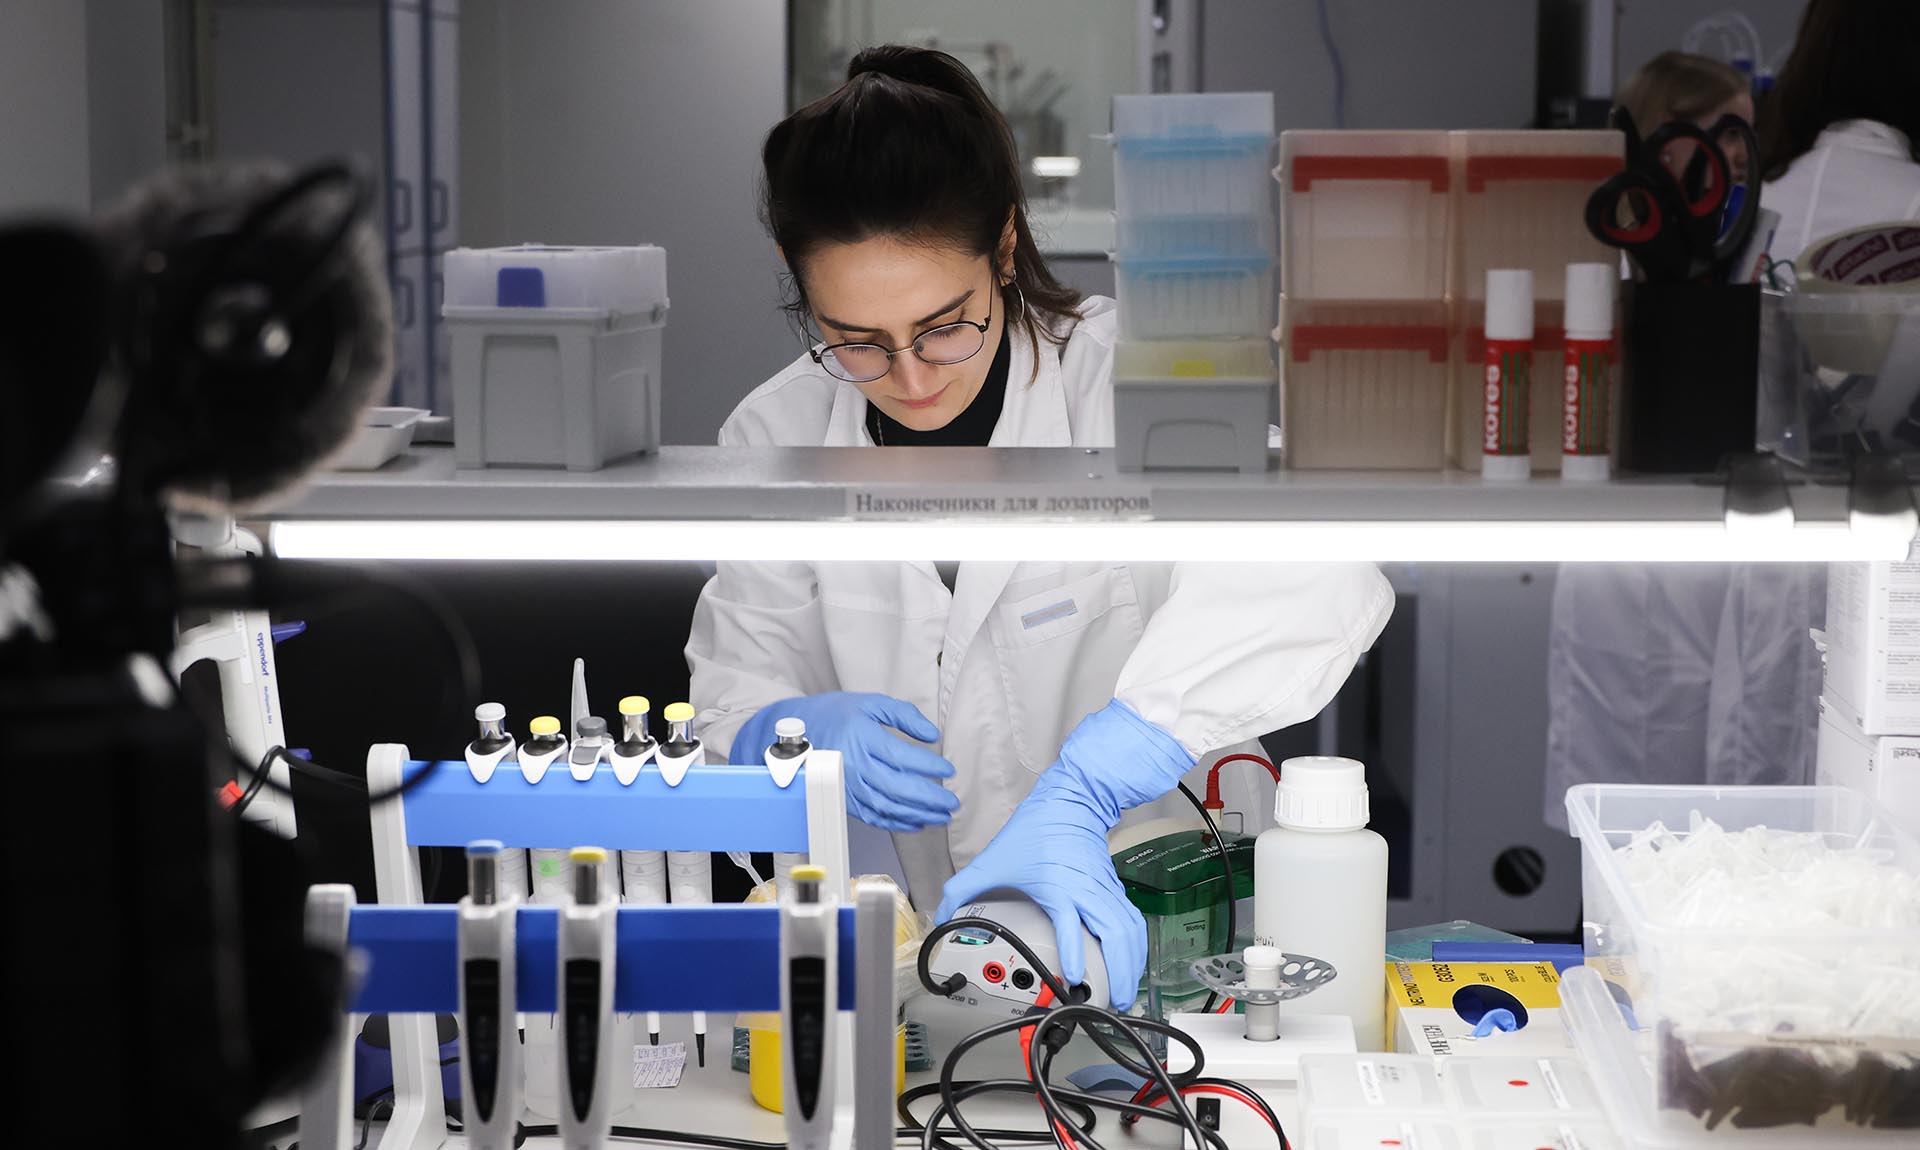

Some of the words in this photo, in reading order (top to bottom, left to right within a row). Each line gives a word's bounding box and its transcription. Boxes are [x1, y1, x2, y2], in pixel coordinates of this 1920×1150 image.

[855, 493, 996, 513] Наконечники
[1002, 497, 1040, 513] для
[1044, 496, 1151, 515] дозаторов
[257, 632, 269, 676] eppendorf
[1185, 923, 1206, 933] Blotting
